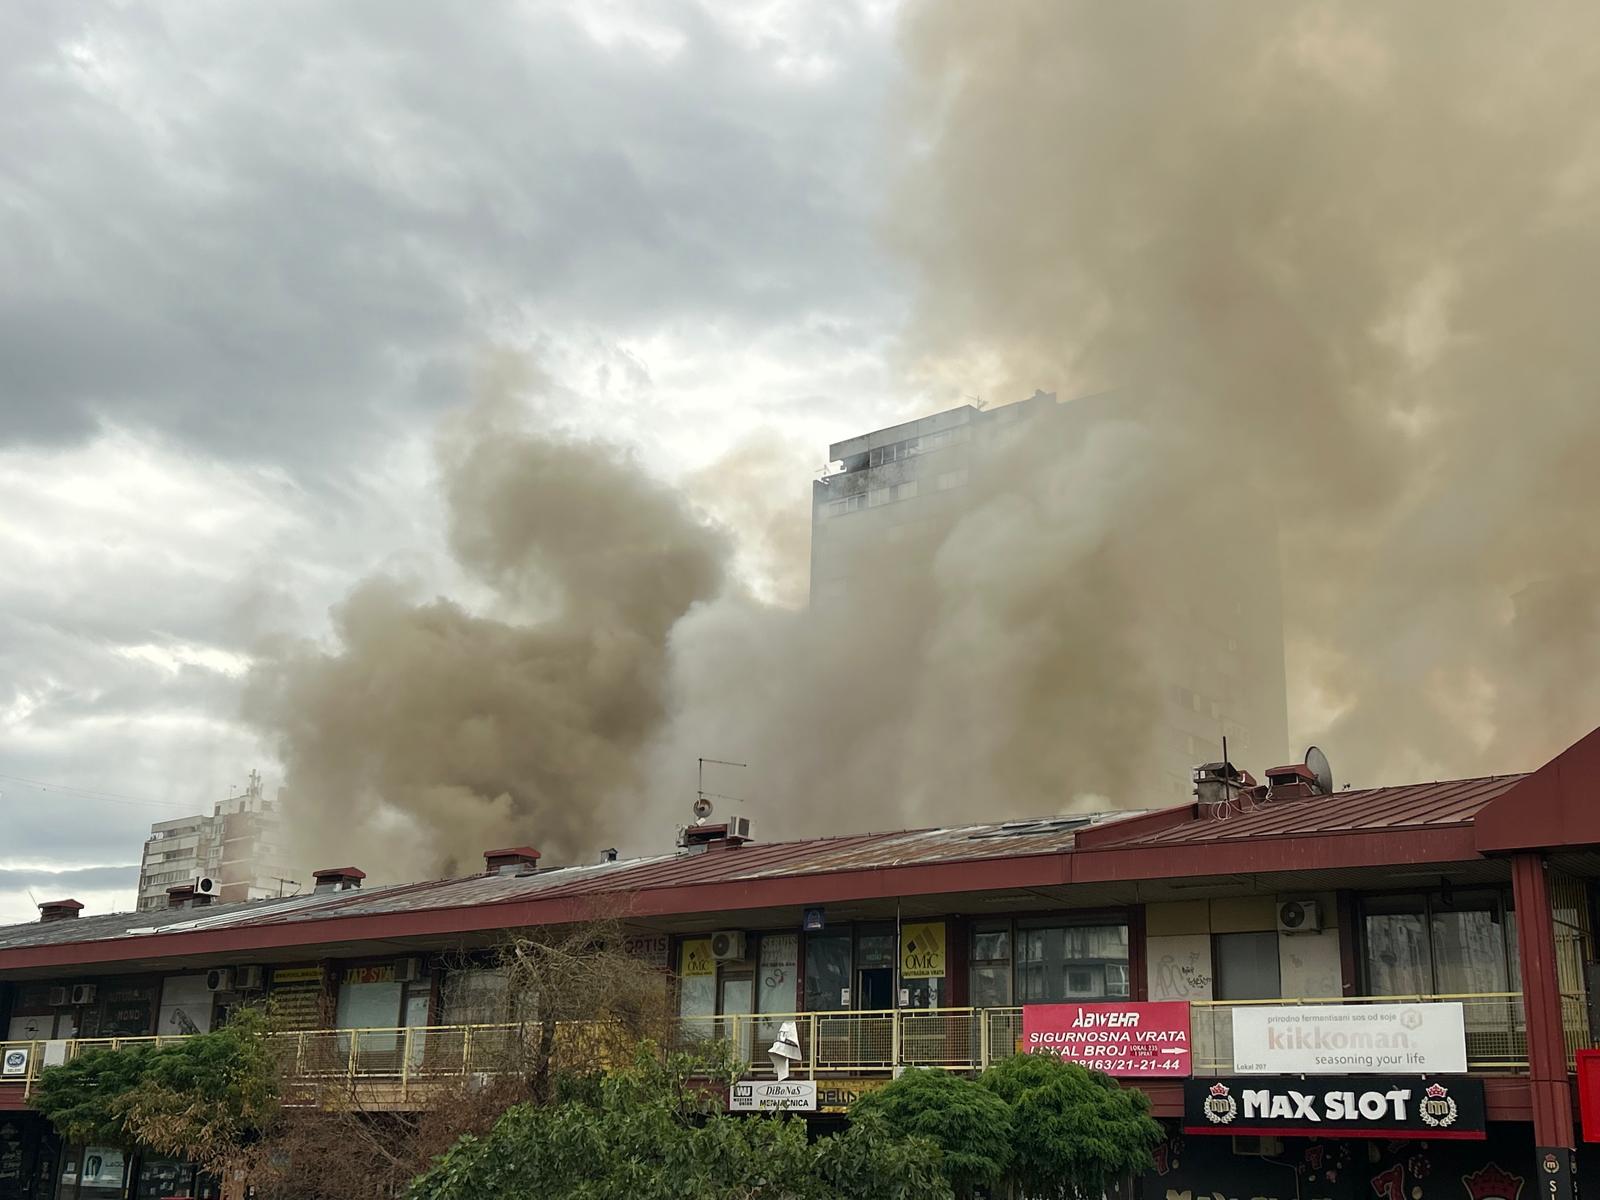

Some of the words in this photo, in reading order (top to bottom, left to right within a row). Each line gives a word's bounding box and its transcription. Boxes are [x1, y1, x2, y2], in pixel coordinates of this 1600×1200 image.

[1267, 1015, 1300, 1024] prirodno
[1302, 1014, 1350, 1022] fermentisani
[1380, 1013, 1397, 1022] soje
[1030, 1032, 1130, 1043] SIGURNOSNA
[1136, 1031, 1186, 1042] VRATA
[1268, 1026, 1409, 1050] kikkoman
[1083, 1045, 1127, 1057] BROJ
[1315, 1054, 1373, 1066] seasoning
[1376, 1056, 1402, 1067] your
[1407, 1053, 1425, 1064] life
[1324, 1089, 1411, 1121] SLOT
